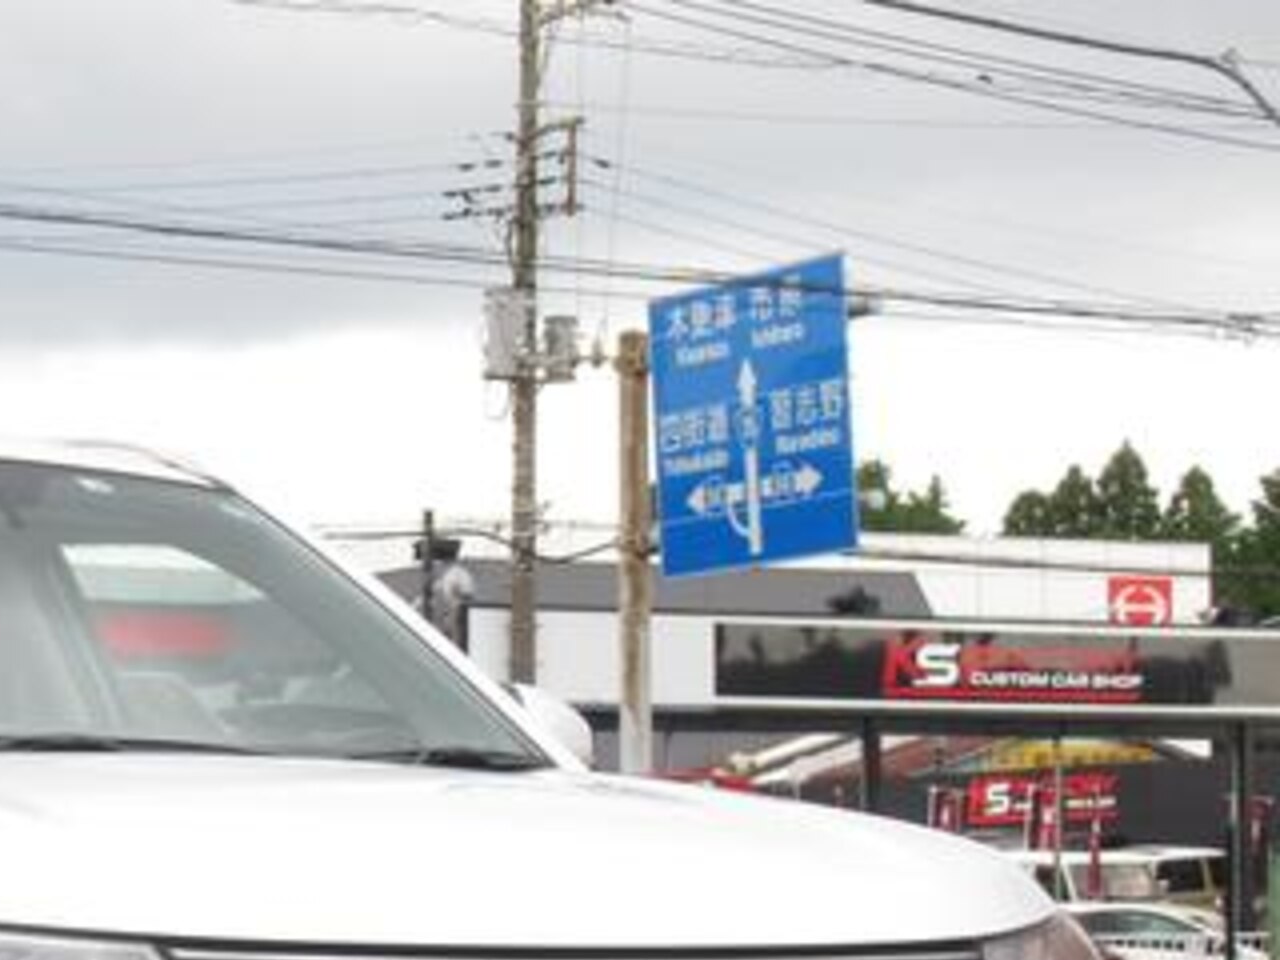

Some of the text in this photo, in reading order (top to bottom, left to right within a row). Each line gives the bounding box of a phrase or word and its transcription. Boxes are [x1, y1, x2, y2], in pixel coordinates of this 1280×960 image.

[970, 670, 1144, 690] CUSTOM CAR SHOP
